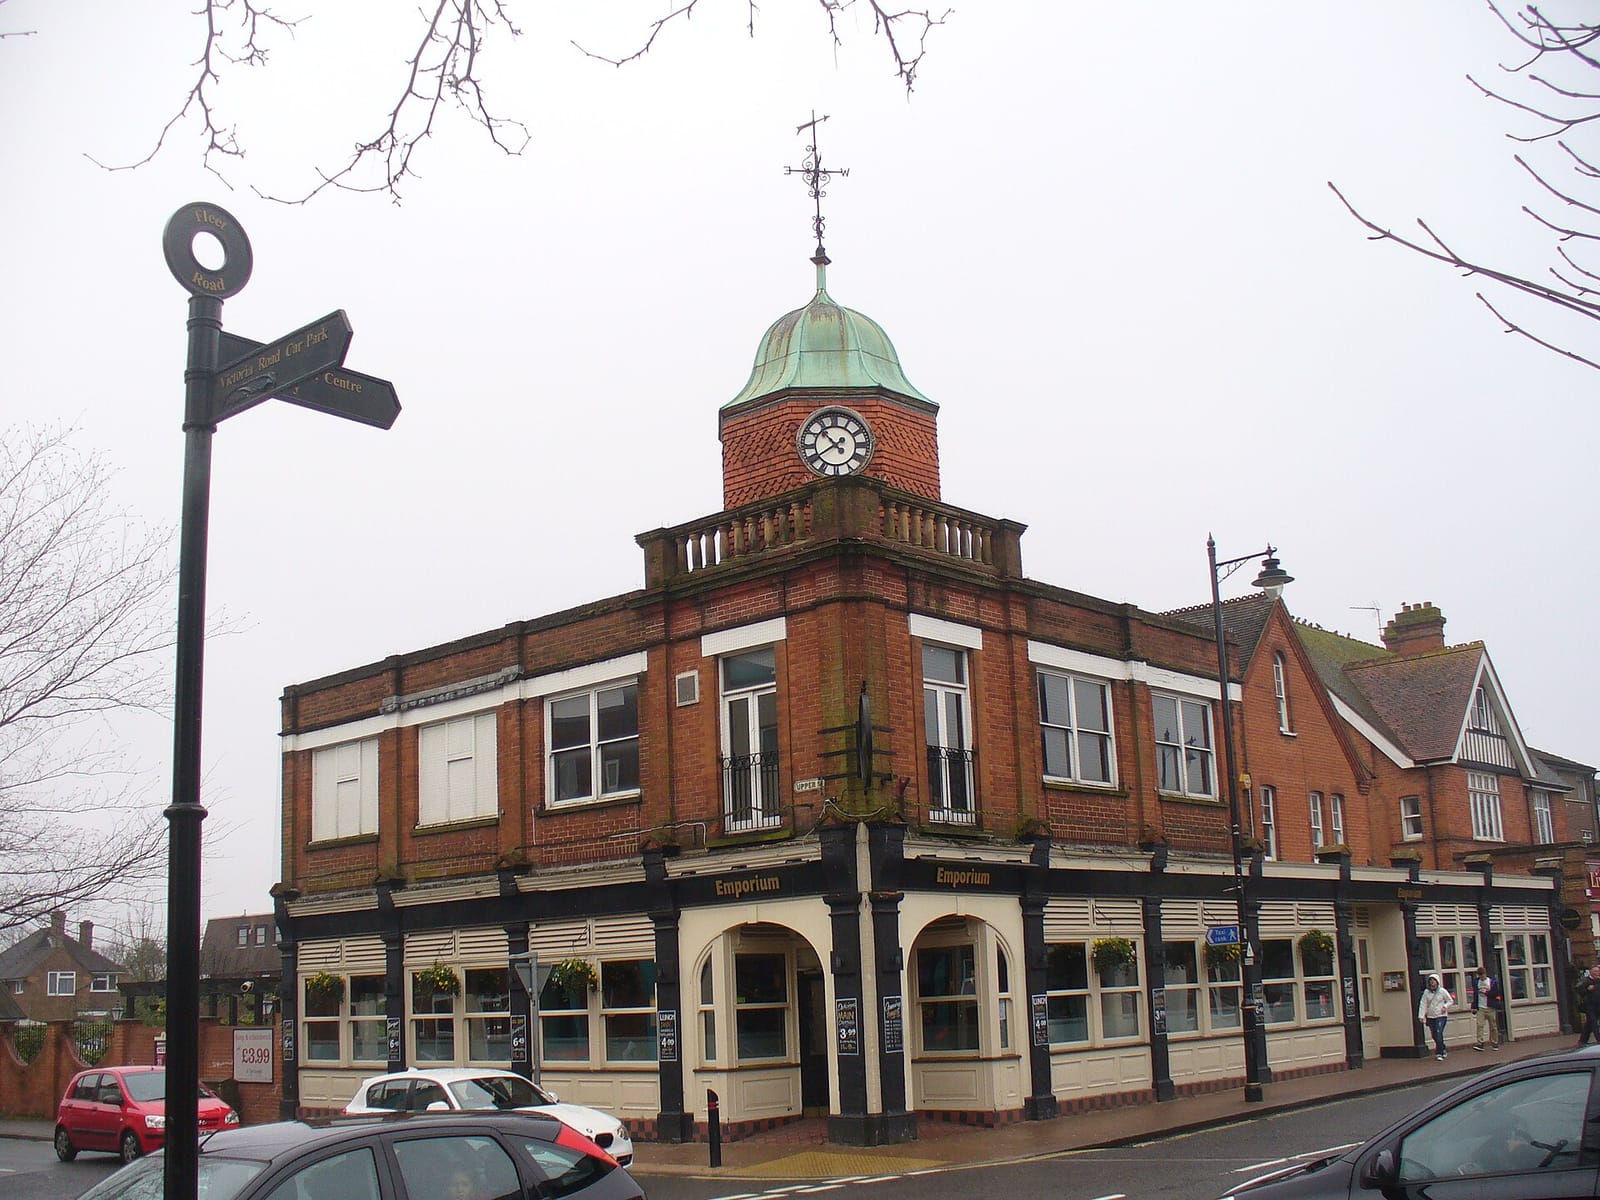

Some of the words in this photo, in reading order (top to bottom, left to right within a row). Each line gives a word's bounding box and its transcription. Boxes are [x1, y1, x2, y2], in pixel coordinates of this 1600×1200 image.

[194, 209, 228, 230] Fleet
[192, 271, 226, 291] Road
[220, 365, 254, 388] Victoria
[258, 349, 281, 371] Road
[285, 341, 303, 357] Car
[306, 327, 329, 347] Park
[324, 371, 363, 393] Centre
[715, 874, 781, 899] Emporium
[936, 866, 991, 889] Emporium
[1589, 871, 1600, 888] Li
[242, 1047, 270, 1064] £3.99
